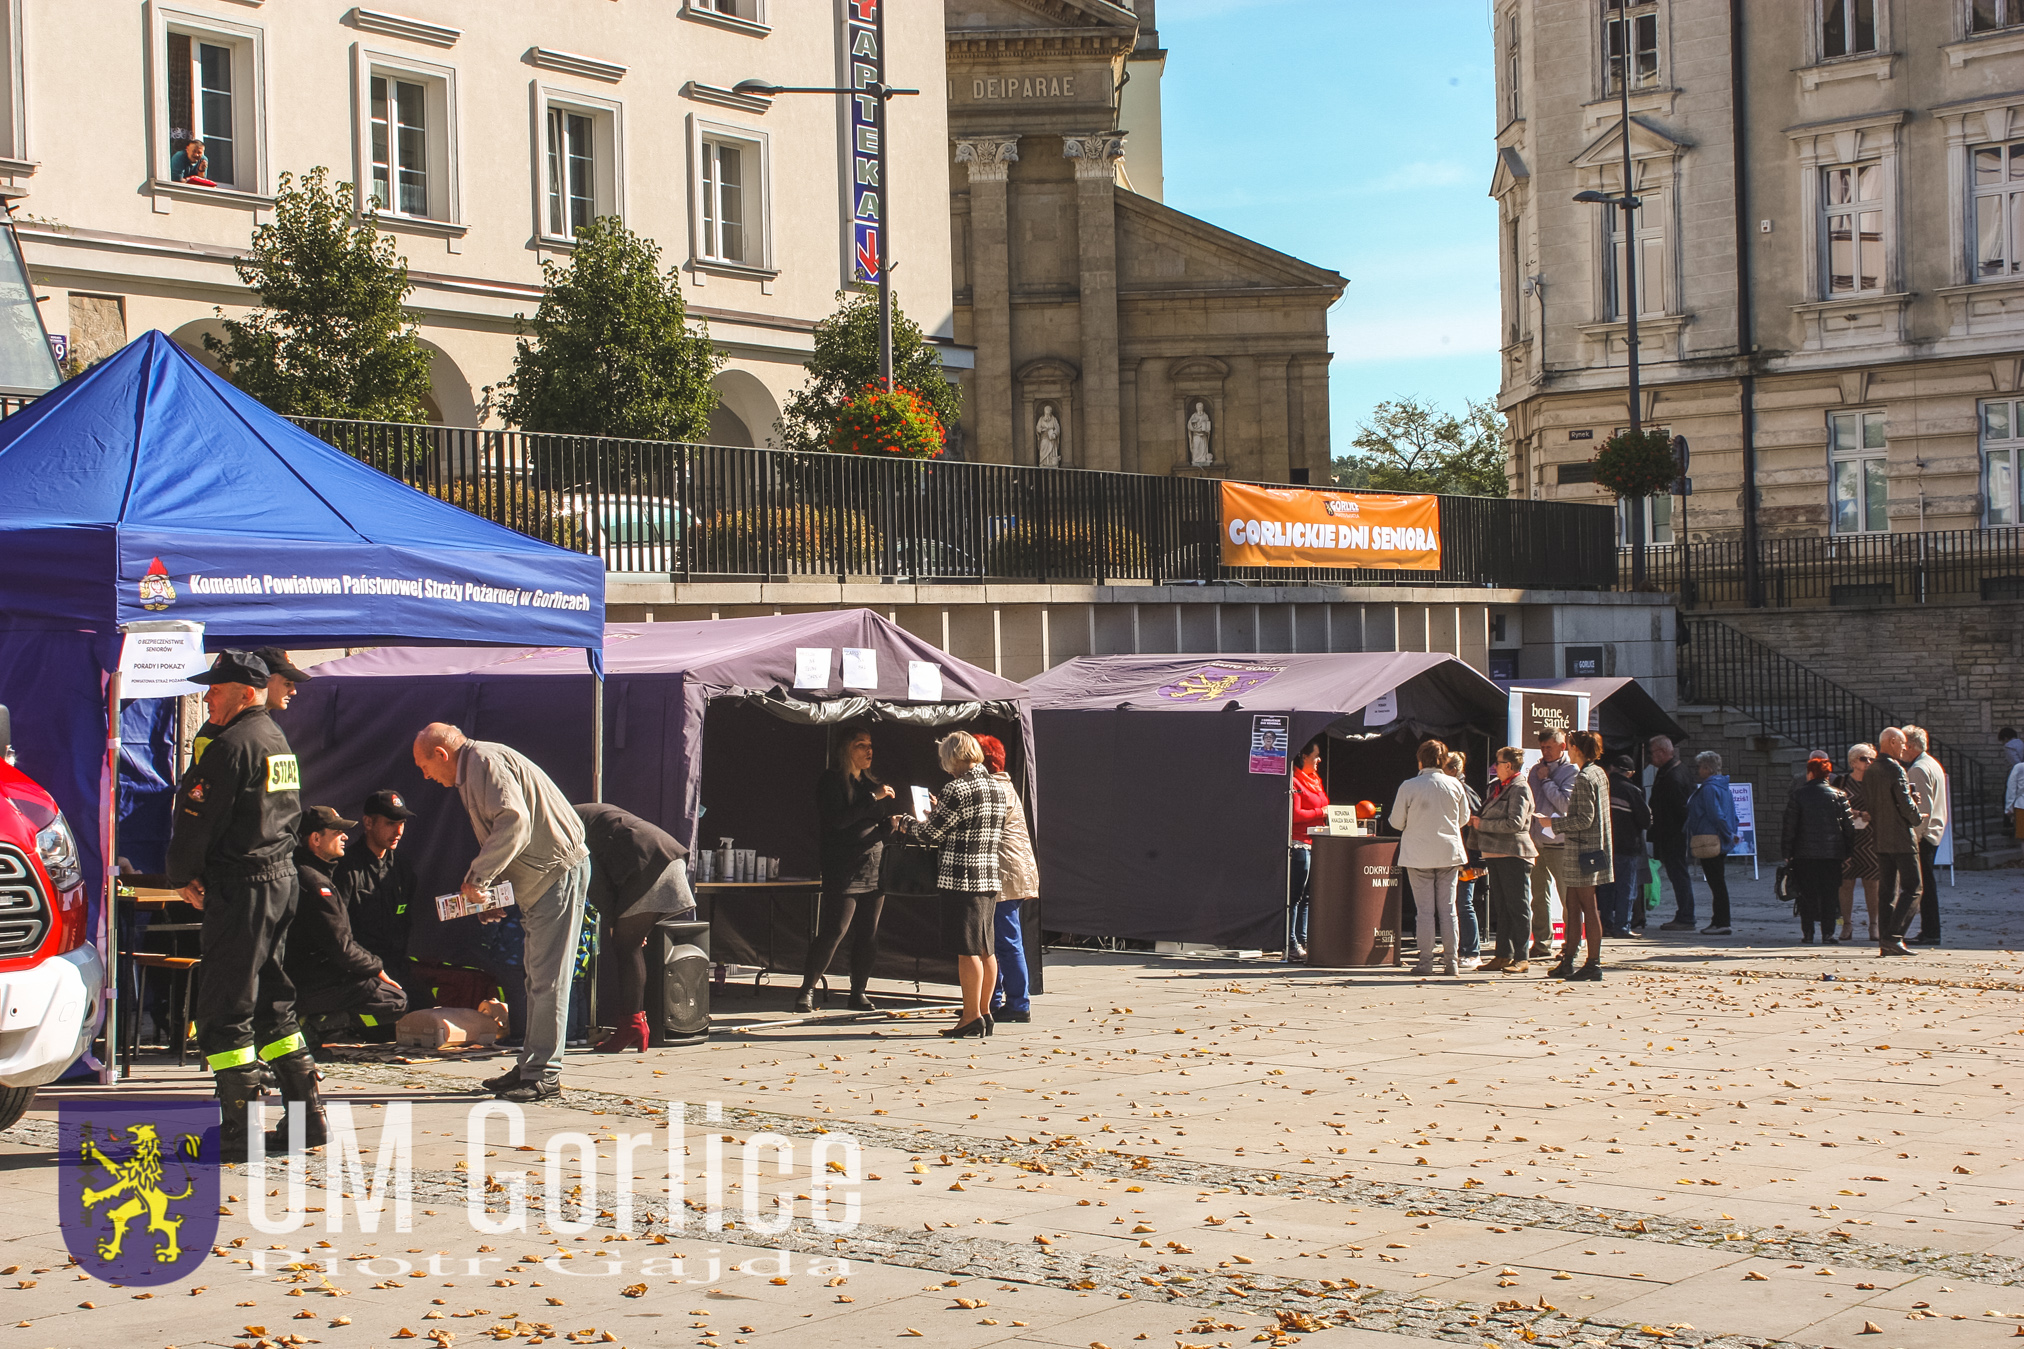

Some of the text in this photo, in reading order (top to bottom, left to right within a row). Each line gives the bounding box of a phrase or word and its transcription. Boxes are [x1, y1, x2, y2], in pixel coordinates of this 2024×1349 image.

[973, 76, 1074, 99] DEIPARAE
[852, 29, 879, 219] APTEKA
[1571, 431, 1590, 439] Rynek
[1330, 500, 1360, 512] GORLICE
[1228, 518, 1438, 551] GORLICKIE DNI SENIORA
[189, 574, 591, 612] Komenda Powiatowa Państwowej Straży Pożarnej w Gorlicach
[1531, 702, 1563, 718] bonne
[1543, 714, 1570, 729] santé
[1363, 865, 1390, 875] ODKRYJ
[1372, 878, 1398, 887] NA NOWO
